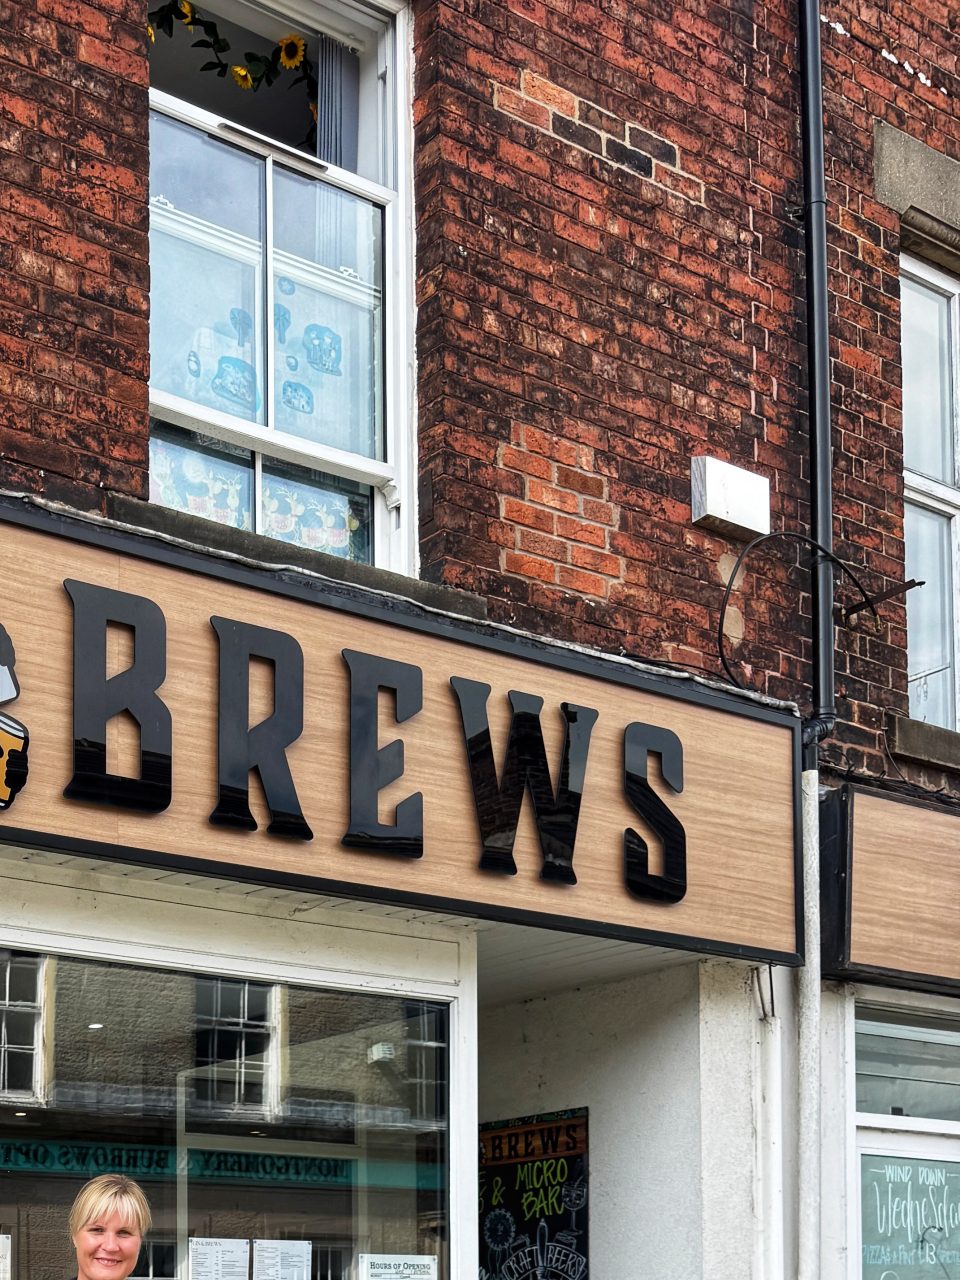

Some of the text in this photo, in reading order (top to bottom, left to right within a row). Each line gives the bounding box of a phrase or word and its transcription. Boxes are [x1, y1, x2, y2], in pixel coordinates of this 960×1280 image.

[62, 578, 688, 905] BREWS
[491, 1124, 578, 1160] BREWS
[492, 1177, 506, 1206] &
[515, 1158, 568, 1190] MICRO
[884, 1165, 945, 1186] WIND DOWN
[521, 1186, 565, 1221] BAR
[504, 1245, 583, 1280] CRAFT BEERS
